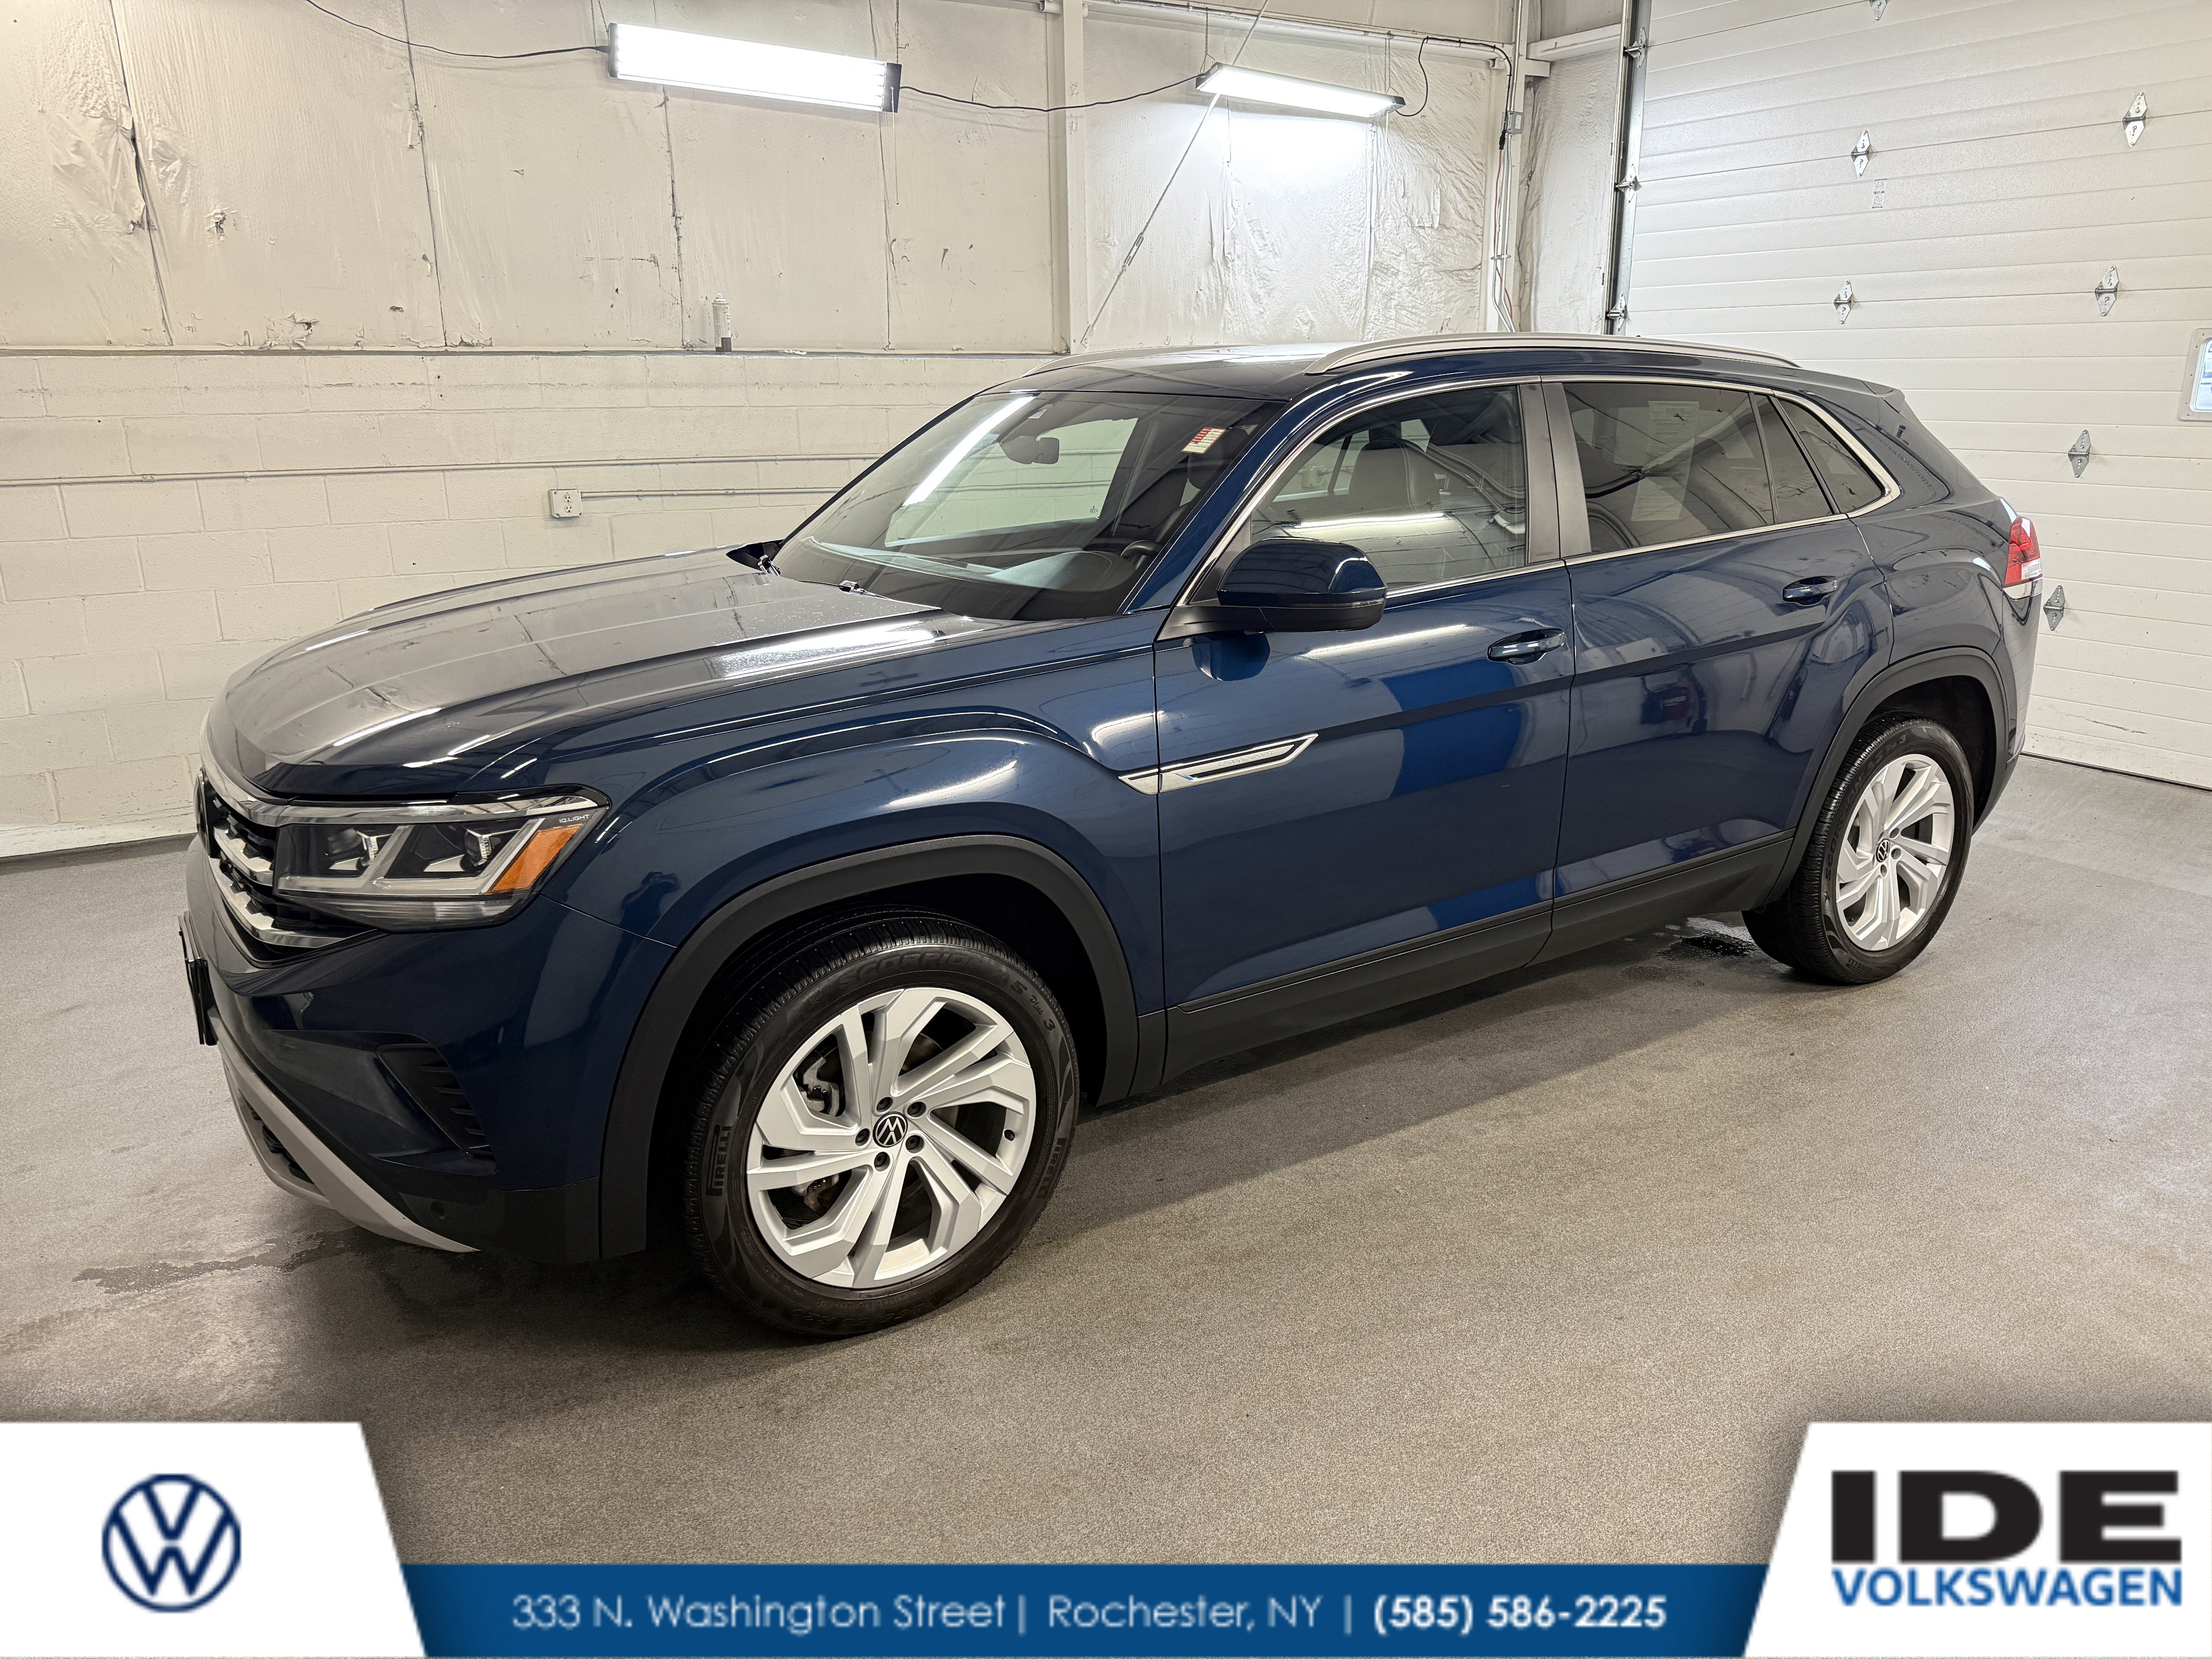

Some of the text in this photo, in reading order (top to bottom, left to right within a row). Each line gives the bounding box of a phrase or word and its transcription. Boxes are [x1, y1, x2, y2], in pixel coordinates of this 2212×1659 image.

[1218, 751, 1274, 766] CROSS SPORT
[559, 814, 590, 823] IQ.LIGHT
[838, 952, 986, 991] SCORPION
[1043, 1018, 1056, 1031] 3
[706, 1124, 732, 1196] PIRELLI
